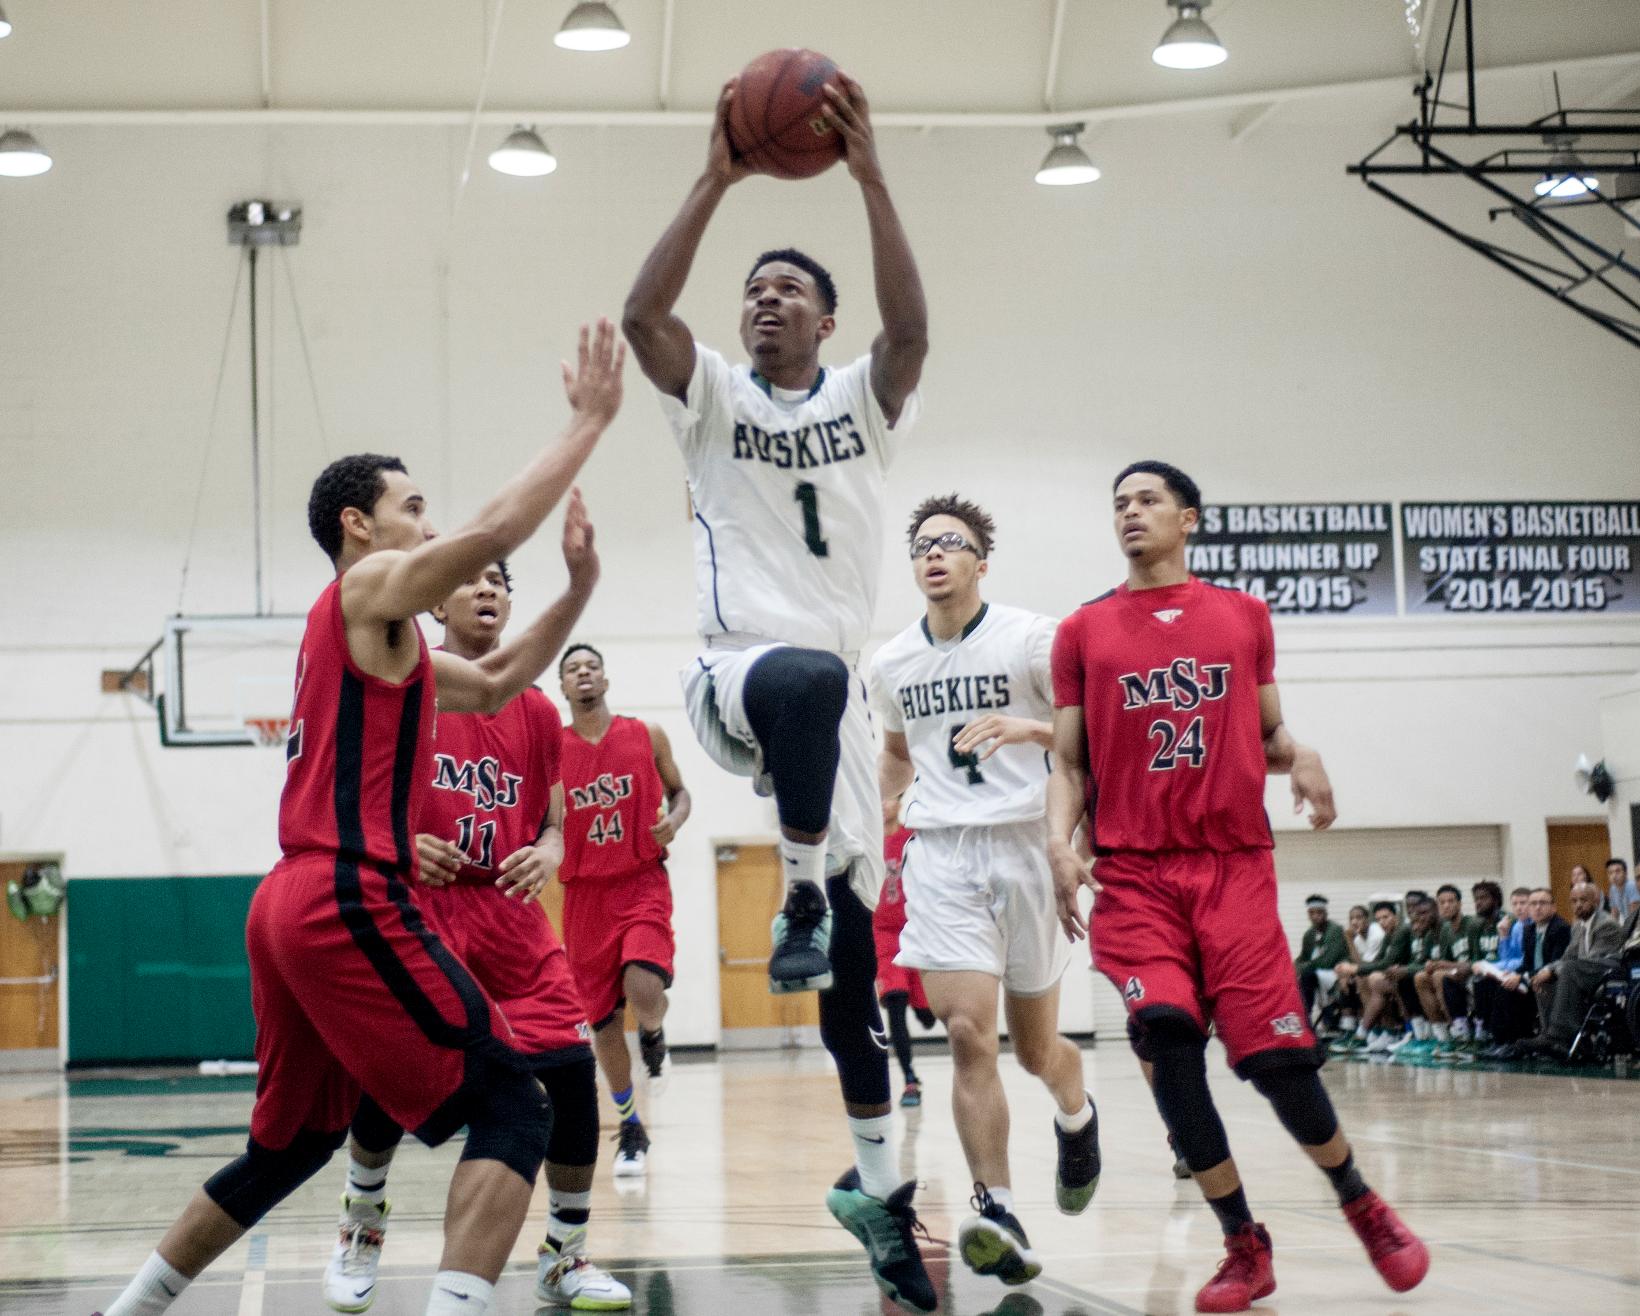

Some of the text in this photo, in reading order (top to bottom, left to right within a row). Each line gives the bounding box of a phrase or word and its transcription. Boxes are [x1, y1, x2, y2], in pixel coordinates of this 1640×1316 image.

[733, 413, 866, 469] HUSKIES
[794, 481, 829, 558] 1
[1226, 504, 1388, 533] BASKETBALL
[1403, 504, 1640, 538] WOMEN'S BASKETBALL
[1184, 542, 1380, 572] TATE RUNNER UP
[1419, 545, 1631, 573] STATE FINAL FOUR
[1200, 576, 1353, 609] 4-2015
[1449, 577, 1606, 610] 2014-2015
[899, 674, 1010, 720] HUSKIES
[1118, 657, 1231, 711] MSJ
[1148, 715, 1206, 772] 24
[431, 753, 524, 812] MSJ
[569, 772, 634, 811] MSJ
[455, 813, 497, 871] 11
[587, 810, 625, 846] 44
